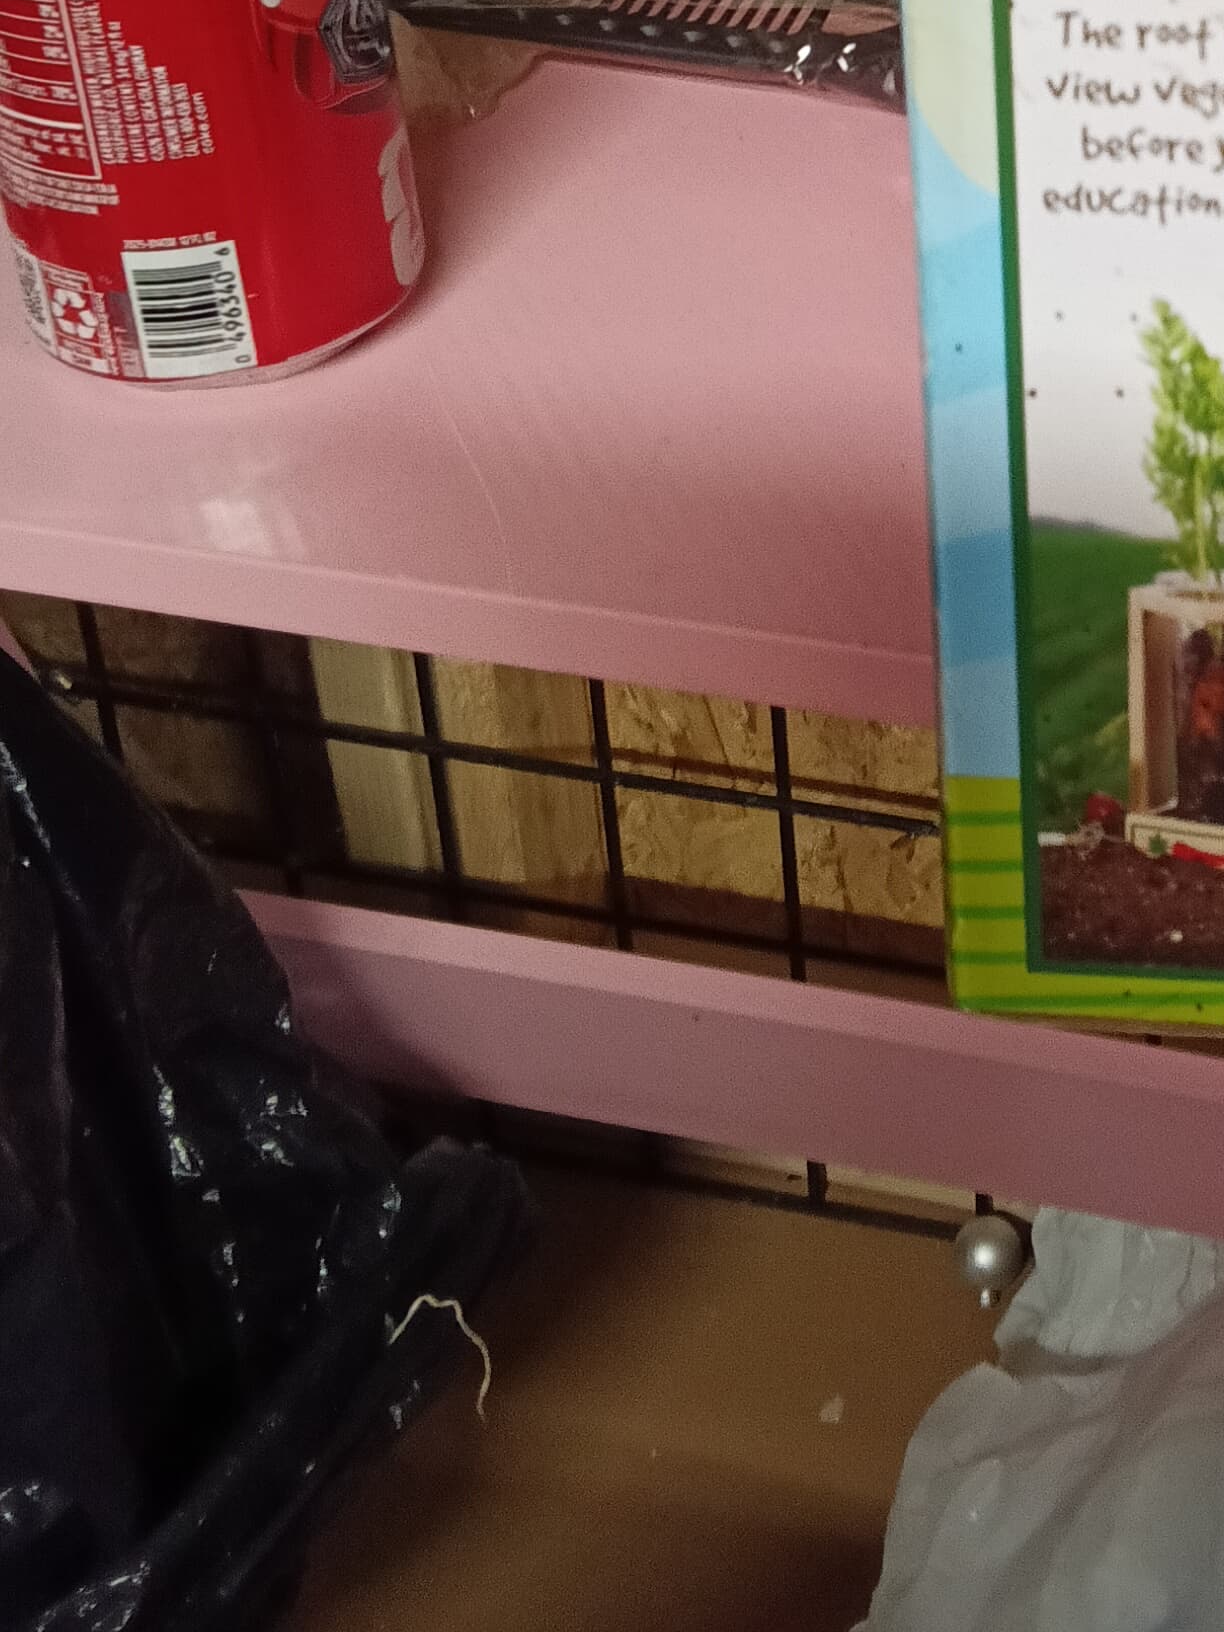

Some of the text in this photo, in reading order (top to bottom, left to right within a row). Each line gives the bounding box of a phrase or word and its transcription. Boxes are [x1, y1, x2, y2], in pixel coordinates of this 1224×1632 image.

[1055, 9, 1124, 49] The
[1135, 18, 1212, 61] root
[1045, 71, 1142, 107] view
[192, 92, 215, 154] coke.com
[1080, 124, 1204, 164] before
[214, 271, 246, 342] 496340
